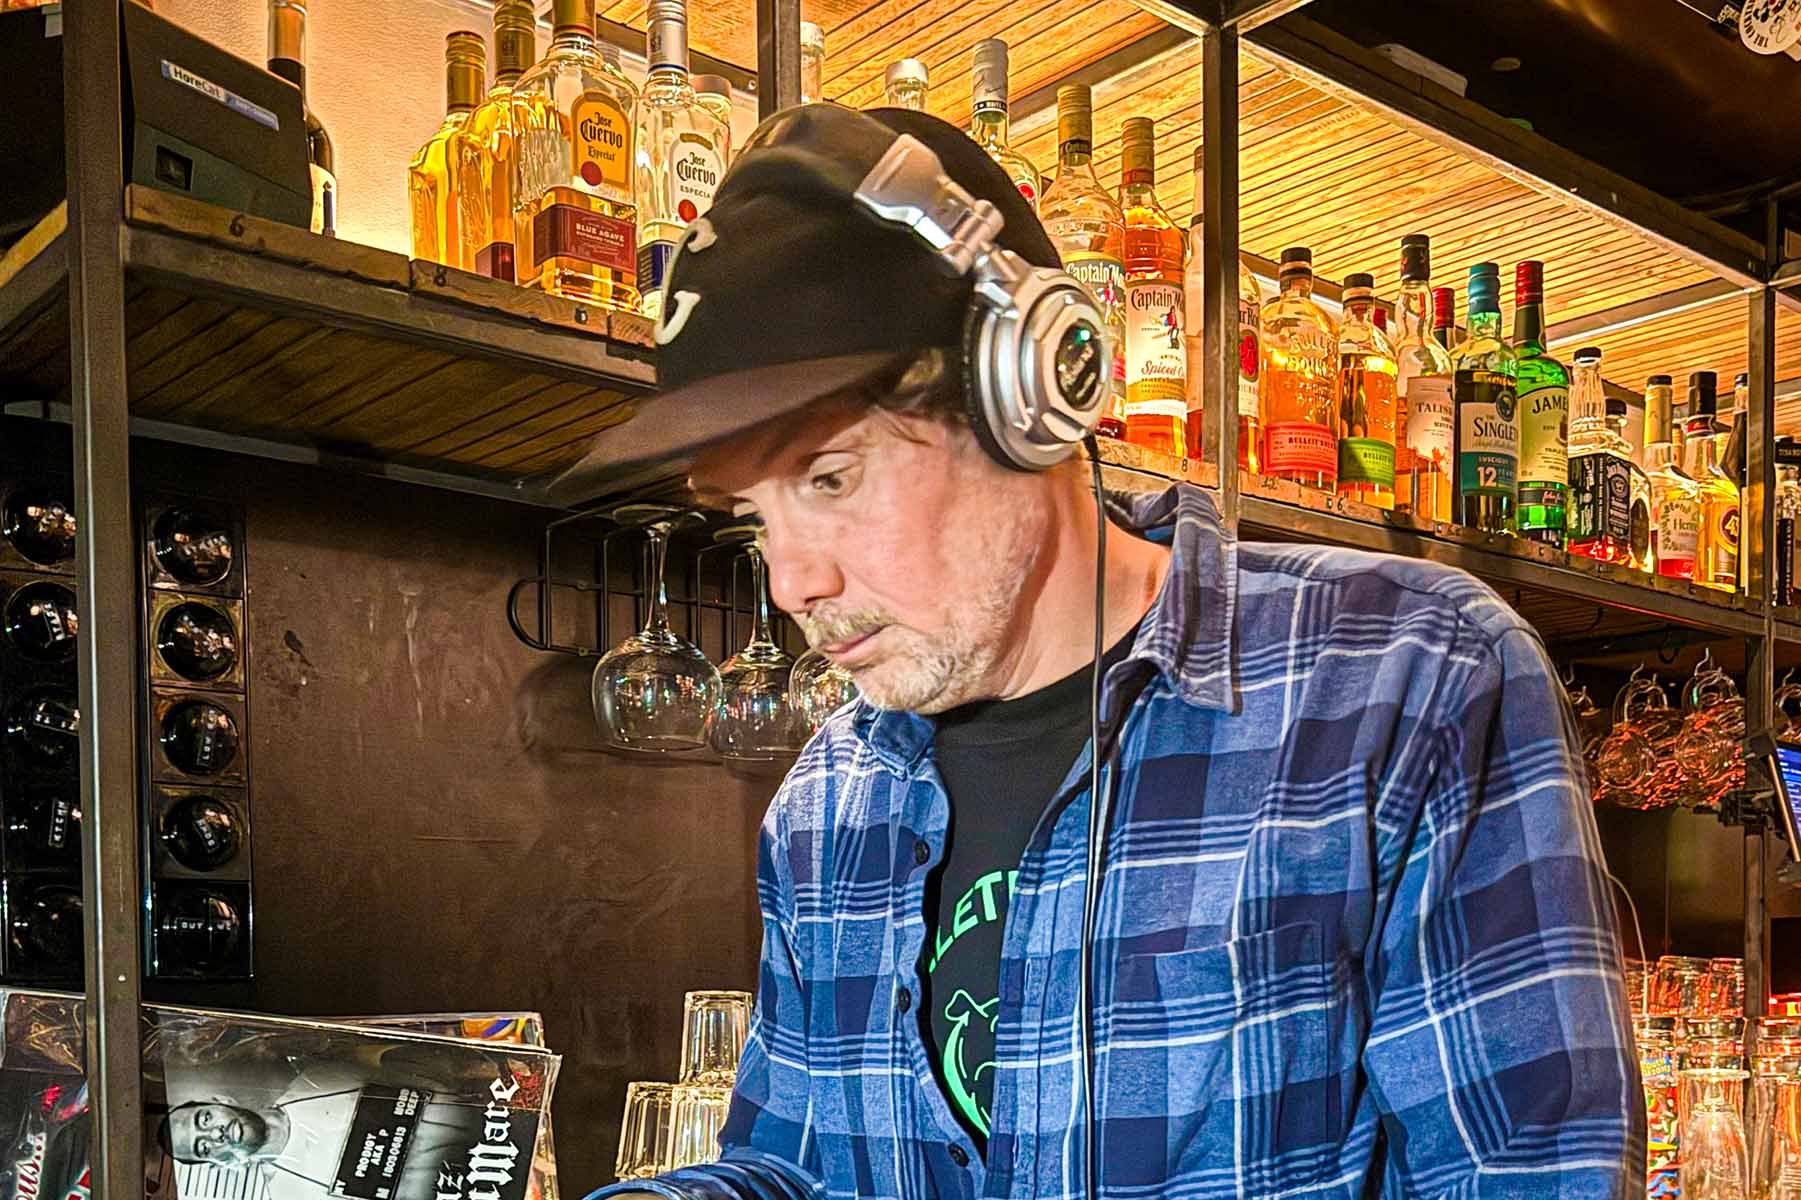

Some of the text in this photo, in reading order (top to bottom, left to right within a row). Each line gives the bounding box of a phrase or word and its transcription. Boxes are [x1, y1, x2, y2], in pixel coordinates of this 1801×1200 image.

[594, 112, 613, 127] Jose
[580, 118, 623, 148] Cuervo
[689, 151, 706, 166] Jose
[676, 158, 716, 186] Cuervo
[576, 223, 597, 234] BLUE
[599, 230, 624, 242] AGAVE
[1065, 262, 1108, 284] Captain
[1131, 288, 1171, 311] Captain
[1477, 466, 1497, 487] 12
[404, 1090, 419, 1116] DEEP
[355, 1133, 377, 1178] PRODIGY
[370, 1128, 389, 1166] AKA P
